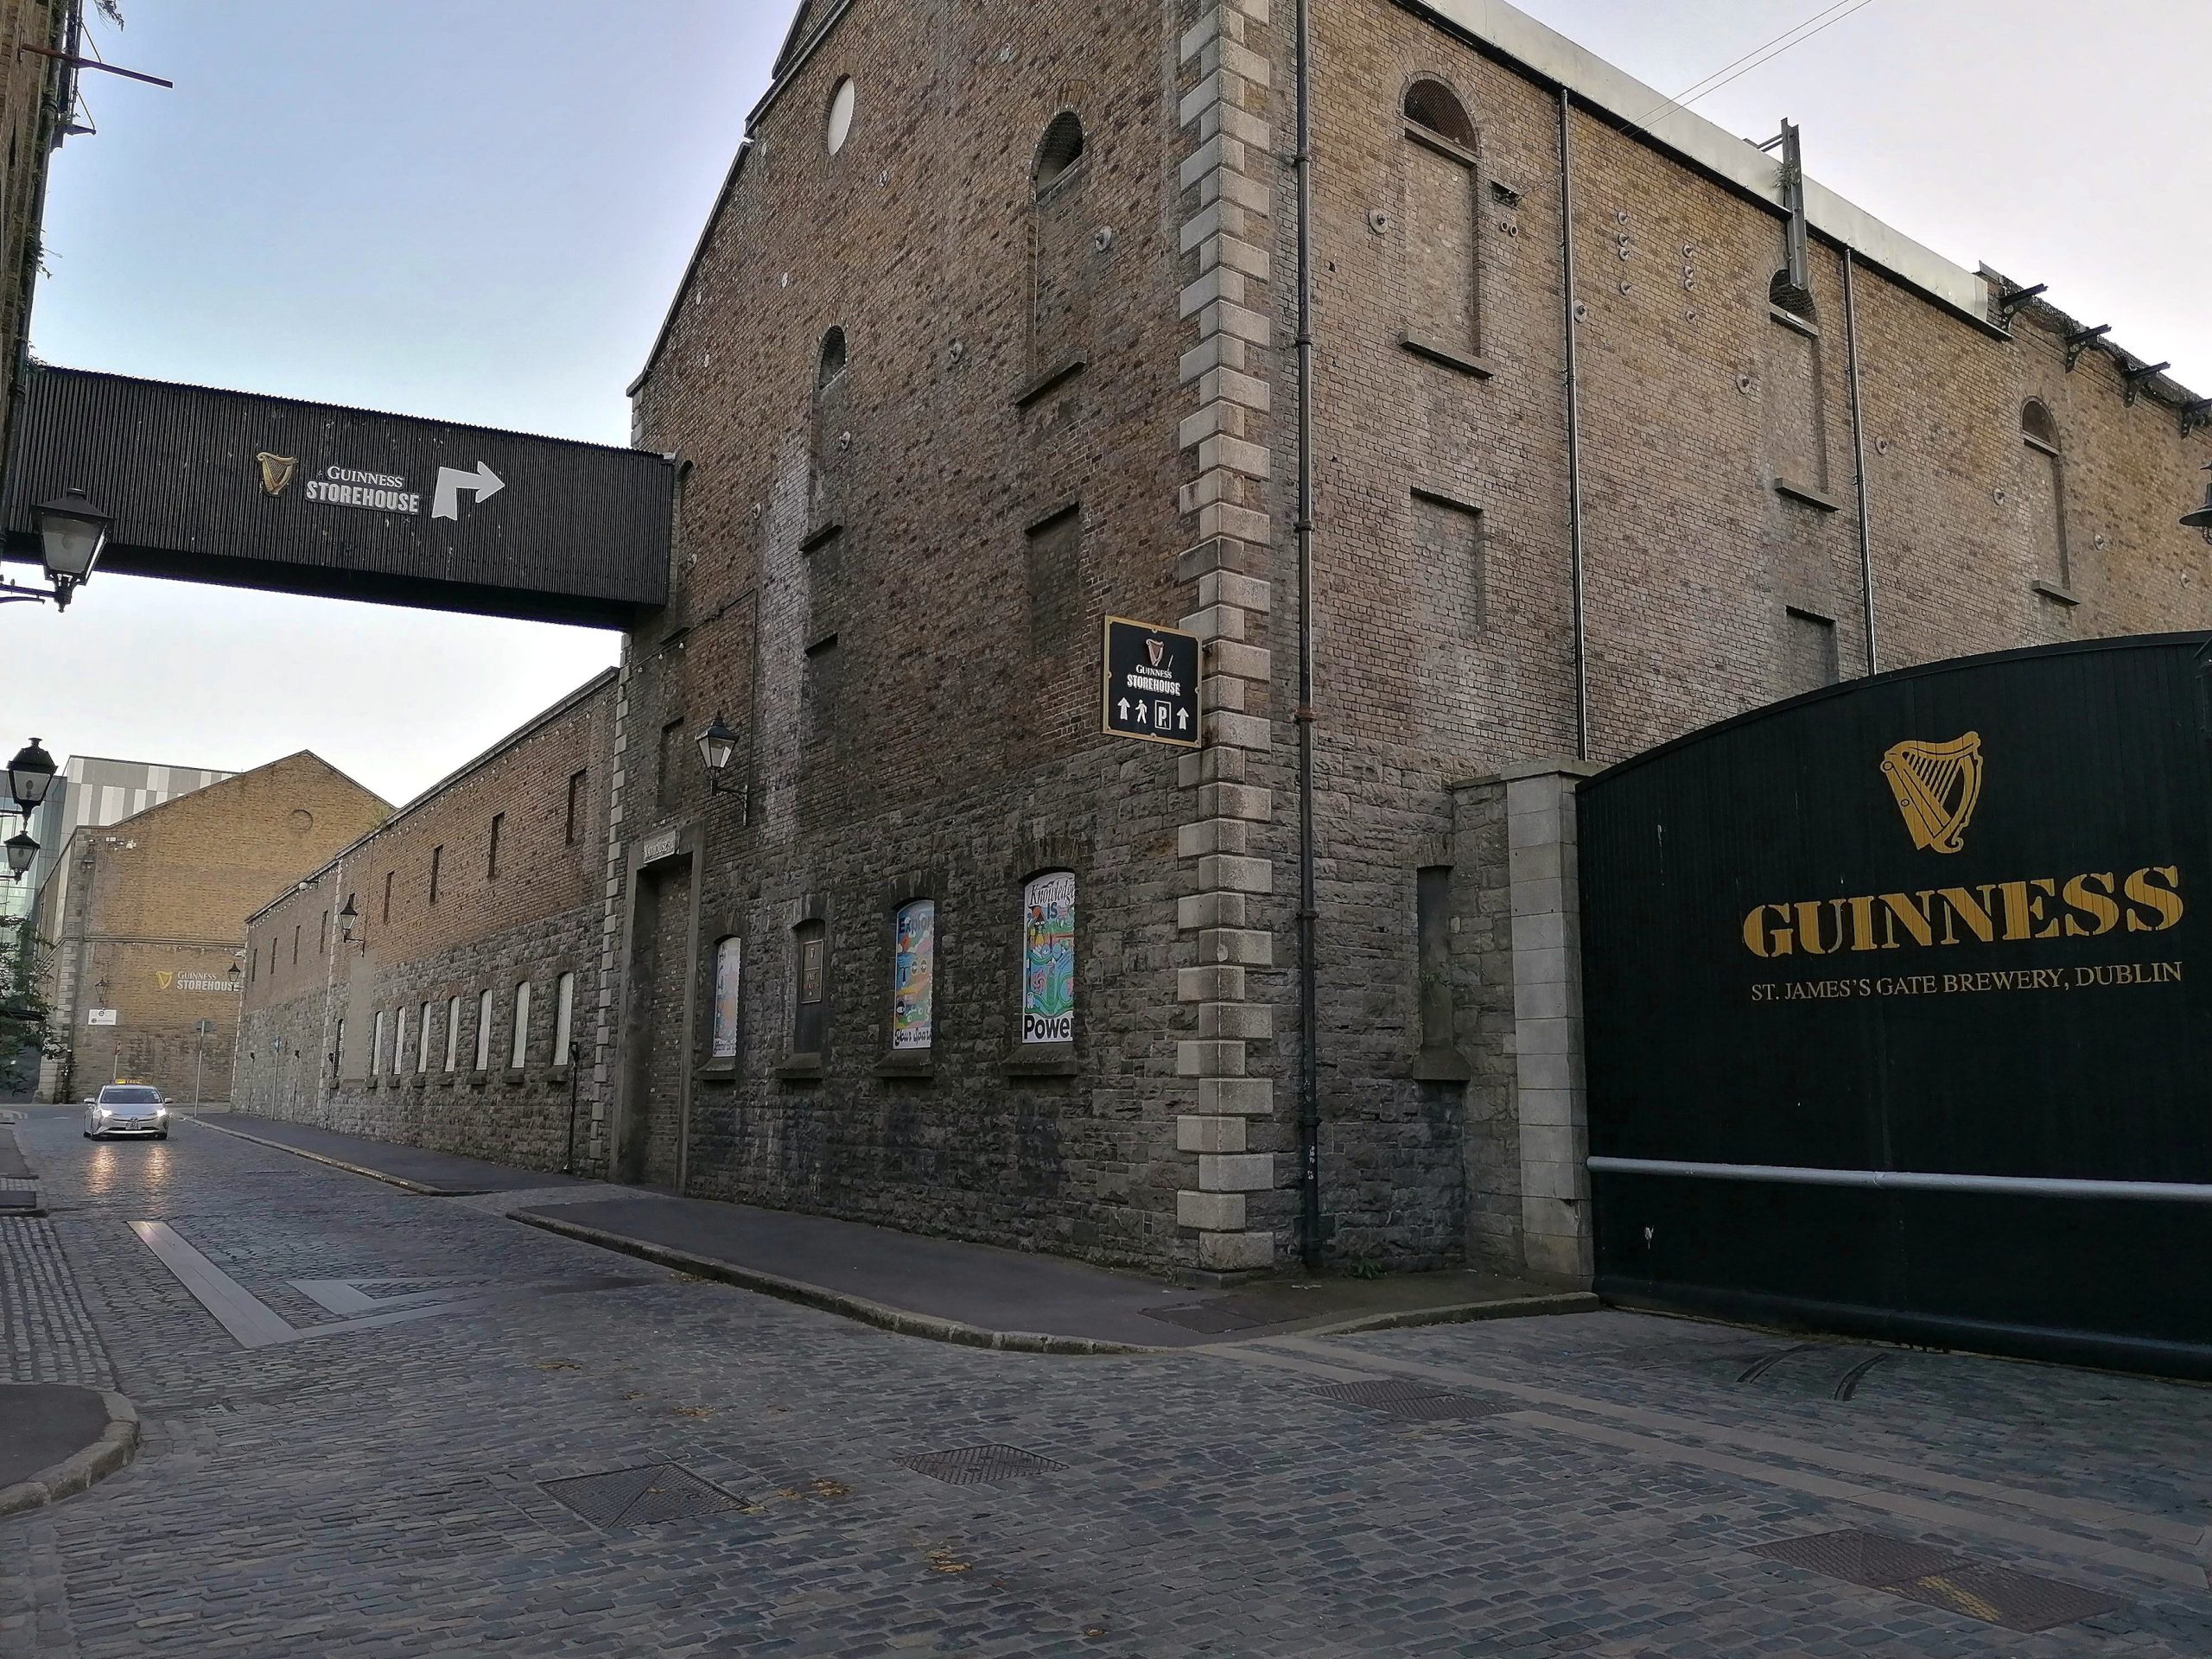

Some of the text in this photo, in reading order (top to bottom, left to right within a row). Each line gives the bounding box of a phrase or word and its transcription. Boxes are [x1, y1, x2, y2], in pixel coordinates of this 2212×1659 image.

[327, 466, 403, 488] GUINNESS
[306, 480, 419, 513] STOREHOUSE
[1136, 664, 1173, 679] GUINNESS
[1127, 674, 1180, 696] STOREHOUSE
[1743, 865, 2184, 957] GUINNESS
[176, 980, 239, 992] STOREHOUSE
[177, 970, 216, 981] GUINNESS
[1751, 961, 2183, 1001] ST. JAMES'S GATE BREWERY, DUBLIN
